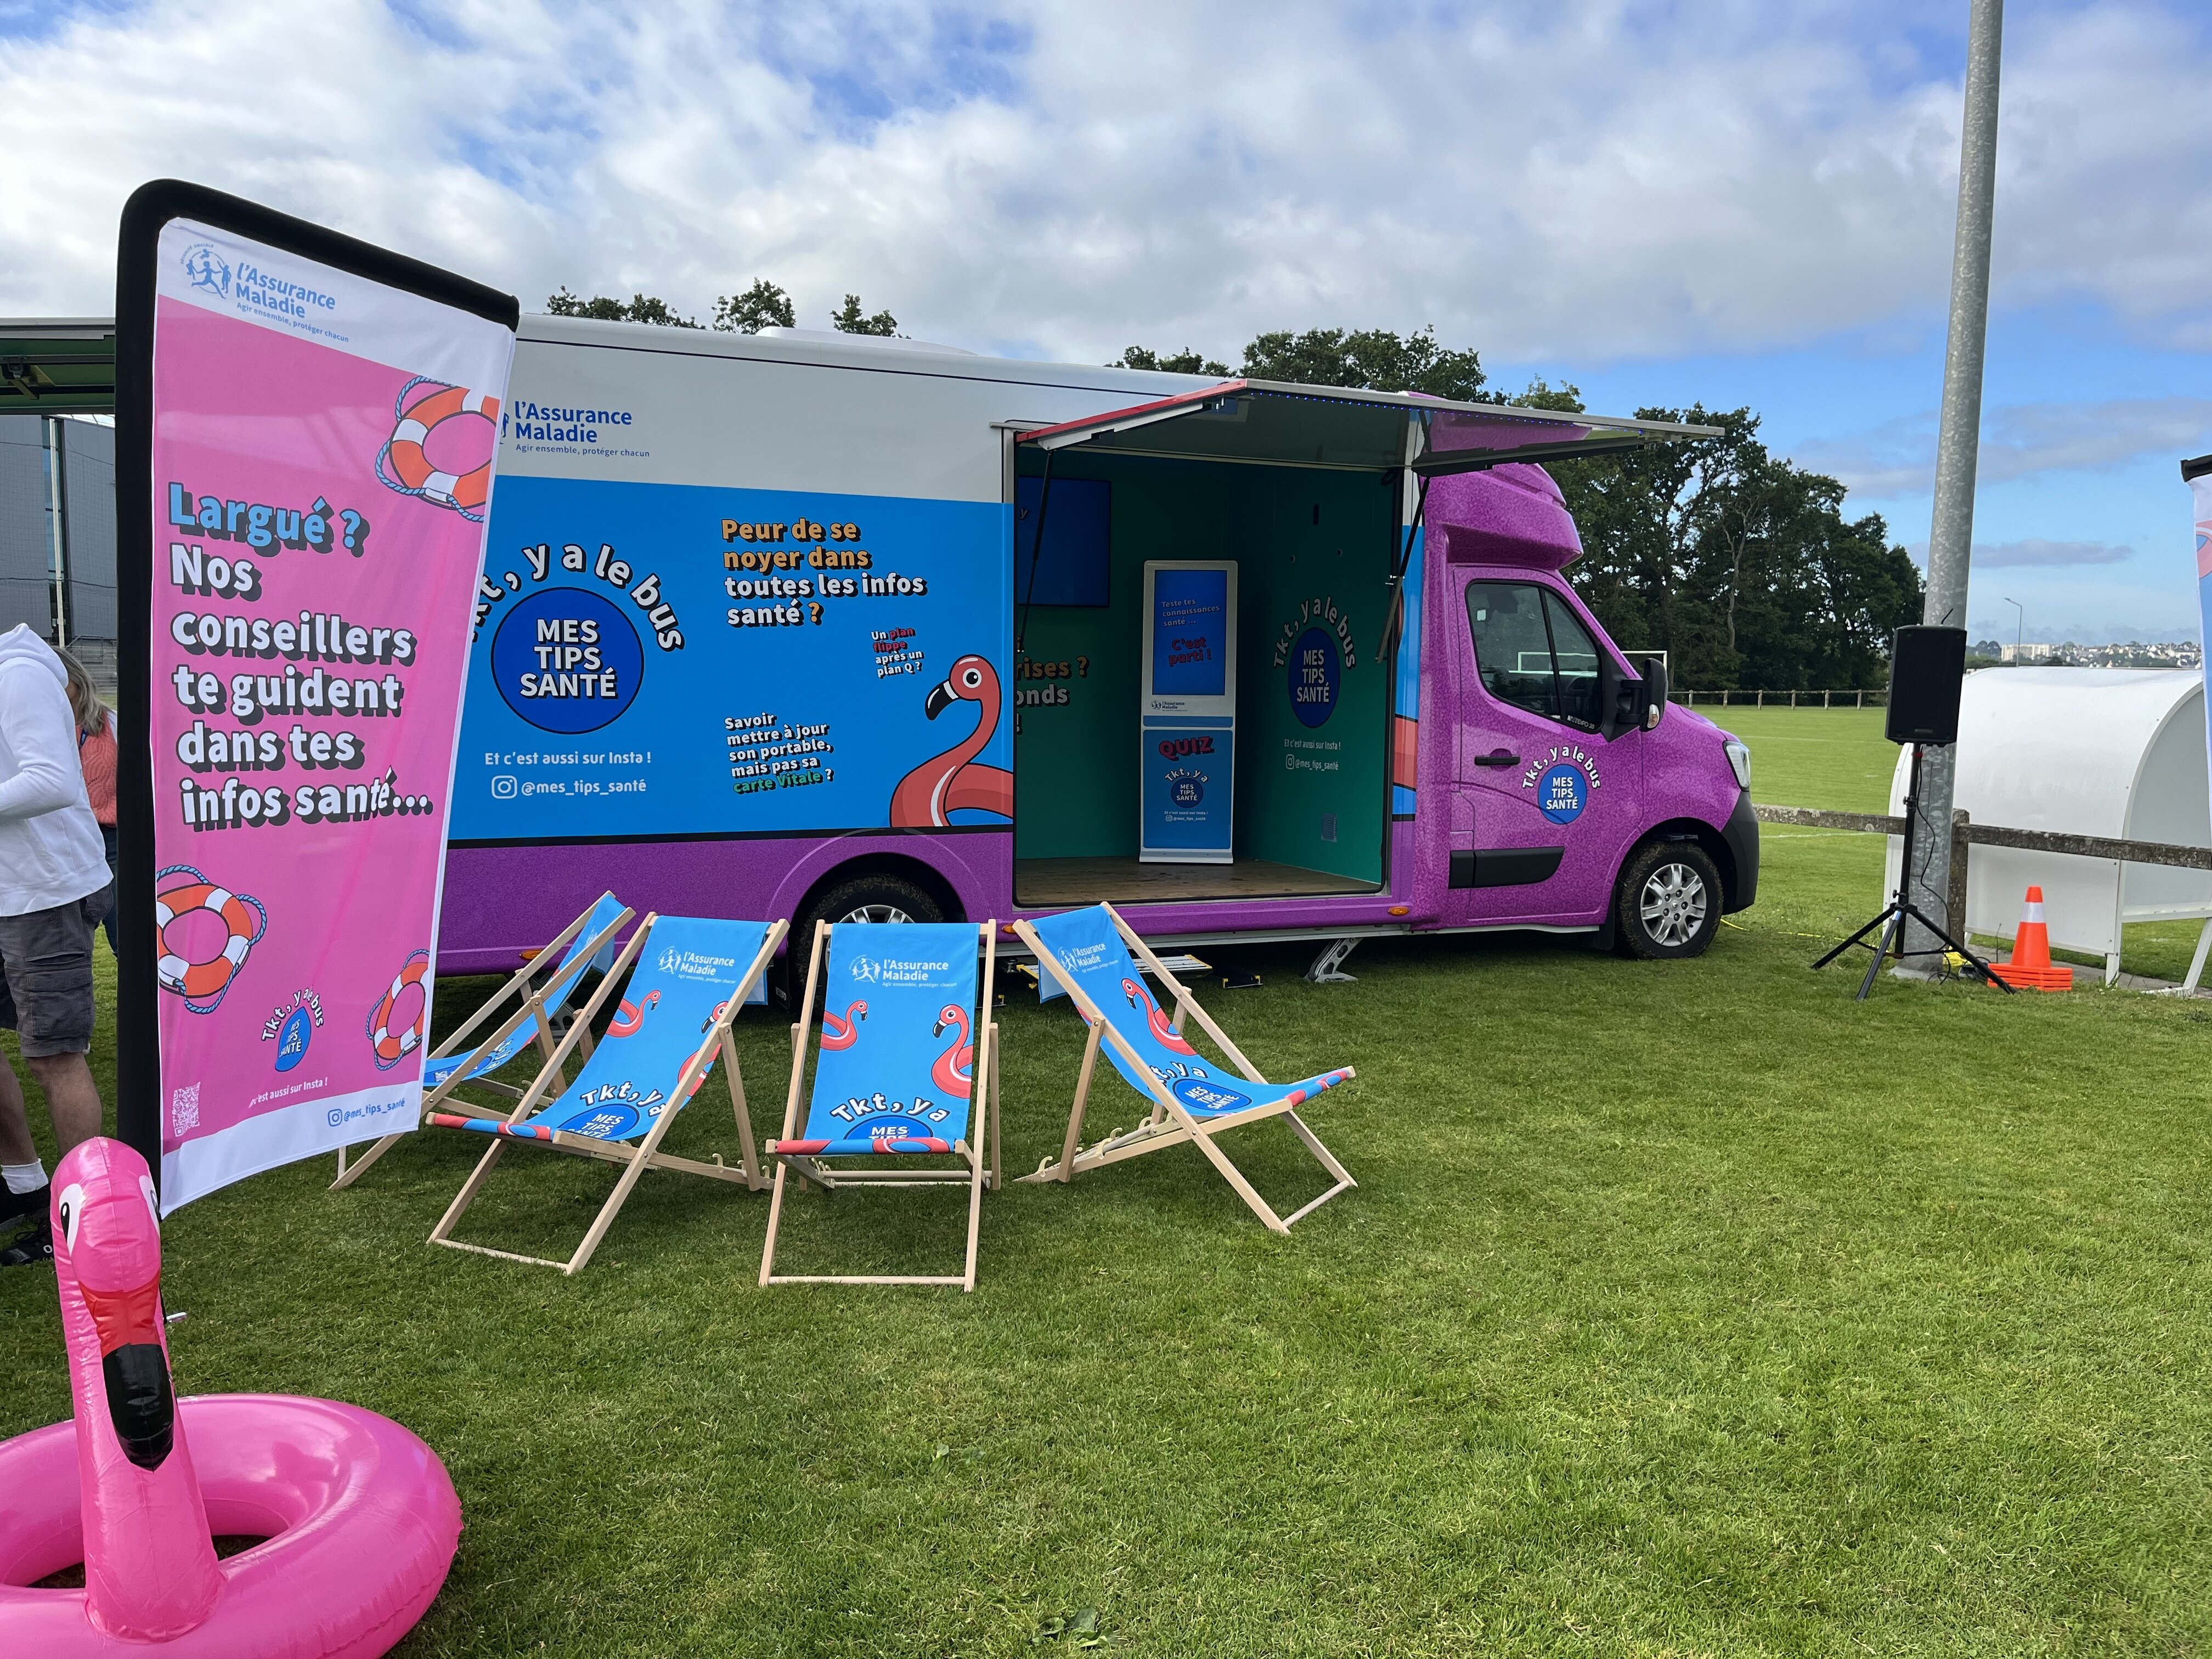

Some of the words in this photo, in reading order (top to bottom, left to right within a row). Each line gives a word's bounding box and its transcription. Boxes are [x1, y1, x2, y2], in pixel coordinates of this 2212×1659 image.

[238, 262, 336, 309] l'Assurance
[235, 283, 305, 318] Maladie
[236, 302, 252, 313] Agir
[254, 308, 291, 326] ensemble,
[293, 320, 323, 335] protéger
[324, 330, 349, 343] chacun
[515, 400, 632, 425] l'Assurance
[516, 422, 597, 443] Maladie
[516, 444, 533, 453] Agir
[536, 446, 580, 455] ensemble,
[583, 447, 618, 457] protéger
[620, 449, 650, 457] chacun
[168, 481, 330, 552] Largué
[340, 508, 366, 553] ?
[721, 519, 785, 541] Peur
[792, 518, 824, 541] de
[830, 522, 859, 541] se
[170, 543, 259, 597] Nos
[724, 551, 802, 574] noyer
[808, 546, 871, 569] dans
[724, 576, 814, 598] toutes
[817, 573, 856, 596] les
[861, 572, 926, 595] infos
[522, 543, 549, 581] y
[562, 544, 586, 572] a
[594, 543, 633, 588] le
[629, 573, 685, 651] bus
[727, 598, 802, 627] santé
[808, 602, 822, 624] ?
[1163, 606, 1220, 617] connaissances
[1163, 617, 1186, 627] santé
[171, 610, 415, 663] conseillers
[537, 619, 600, 644] MES
[871, 631, 887, 640] Un
[889, 628, 915, 640] plan
[1301, 600, 1308, 624] y
[1313, 598, 1322, 615] a
[1336, 614, 1357, 669] bus
[873, 641, 907, 652] flippe
[534, 646, 602, 672] TIPS
[876, 651, 907, 665] après
[909, 651, 923, 659] un
[1076, 656, 1088, 677] ?
[1169, 648, 1204, 667] parti
[1207, 648, 1212, 660] !
[1303, 649, 1325, 666] MES
[877, 665, 902, 678] plan
[904, 663, 915, 674] Q
[915, 662, 921, 670] ?
[1302, 668, 1325, 684] TIPS
[172, 664, 224, 710] te
[232, 664, 403, 721] guident
[520, 667, 618, 698] SANTÉ
[1296, 681, 1330, 703] SANTÉ
[724, 712, 776, 730] Savoir
[177, 720, 282, 769] dans
[289, 725, 361, 766] tes
[726, 730, 781, 746] mettre
[783, 724, 793, 739] à
[795, 724, 828, 739] jour
[1284, 738, 1289, 747] Et
[1302, 740, 1315, 749] aussi
[1325, 741, 1338, 750] Insta
[485, 753, 500, 765] Et
[542, 751, 579, 764] aussi
[583, 754, 605, 764] sur
[609, 752, 643, 764] Insta
[647, 752, 651, 763] !
[729, 748, 758, 762] son
[760, 738, 833, 760] portable,
[1159, 736, 1214, 760] QUIZ
[731, 761, 769, 778] mais
[772, 759, 799, 774] pas
[802, 757, 819, 768] sa
[1192, 770, 1201, 778] y
[1295, 759, 1339, 771] @mes_tips_santé
[1549, 747, 1558, 762] y
[1562, 746, 1570, 757] a
[1572, 746, 1584, 763] le
[1584, 757, 1601, 789] bus
[521, 779, 646, 796] @mes_tips_santé
[733, 778, 774, 793] carte
[776, 770, 822, 787] Vitale
[825, 768, 833, 780] ?
[1553, 777, 1573, 787] MES
[179, 777, 286, 828] infos
[1546, 797, 1578, 810] SANTÉ
[1551, 788, 1573, 798] TIPS
[680, 963, 716, 975] Maladie
[884, 959, 949, 970] l'Assurance
[1077, 954, 1101, 967] Maladie
[883, 970, 928, 980] Maladie
[293, 990, 301, 1007] y
[311, 994, 324, 1028] bus
[269, 1085, 289, 1100] aussi
[290, 1084, 302, 1094] sur
[303, 1079, 323, 1090] Insta
[324, 1076, 328, 1086] !
[1185, 1086, 1209, 1099] MES
[1197, 1092, 1224, 1105] TIPS
[344, 1097, 405, 1121] @mes_tips_santé
[1207, 1093, 1240, 1110] SANTÉ
[582, 1122, 614, 1132] TIPS
[591, 1113, 625, 1125] MES
[871, 1126, 909, 1135] MES
